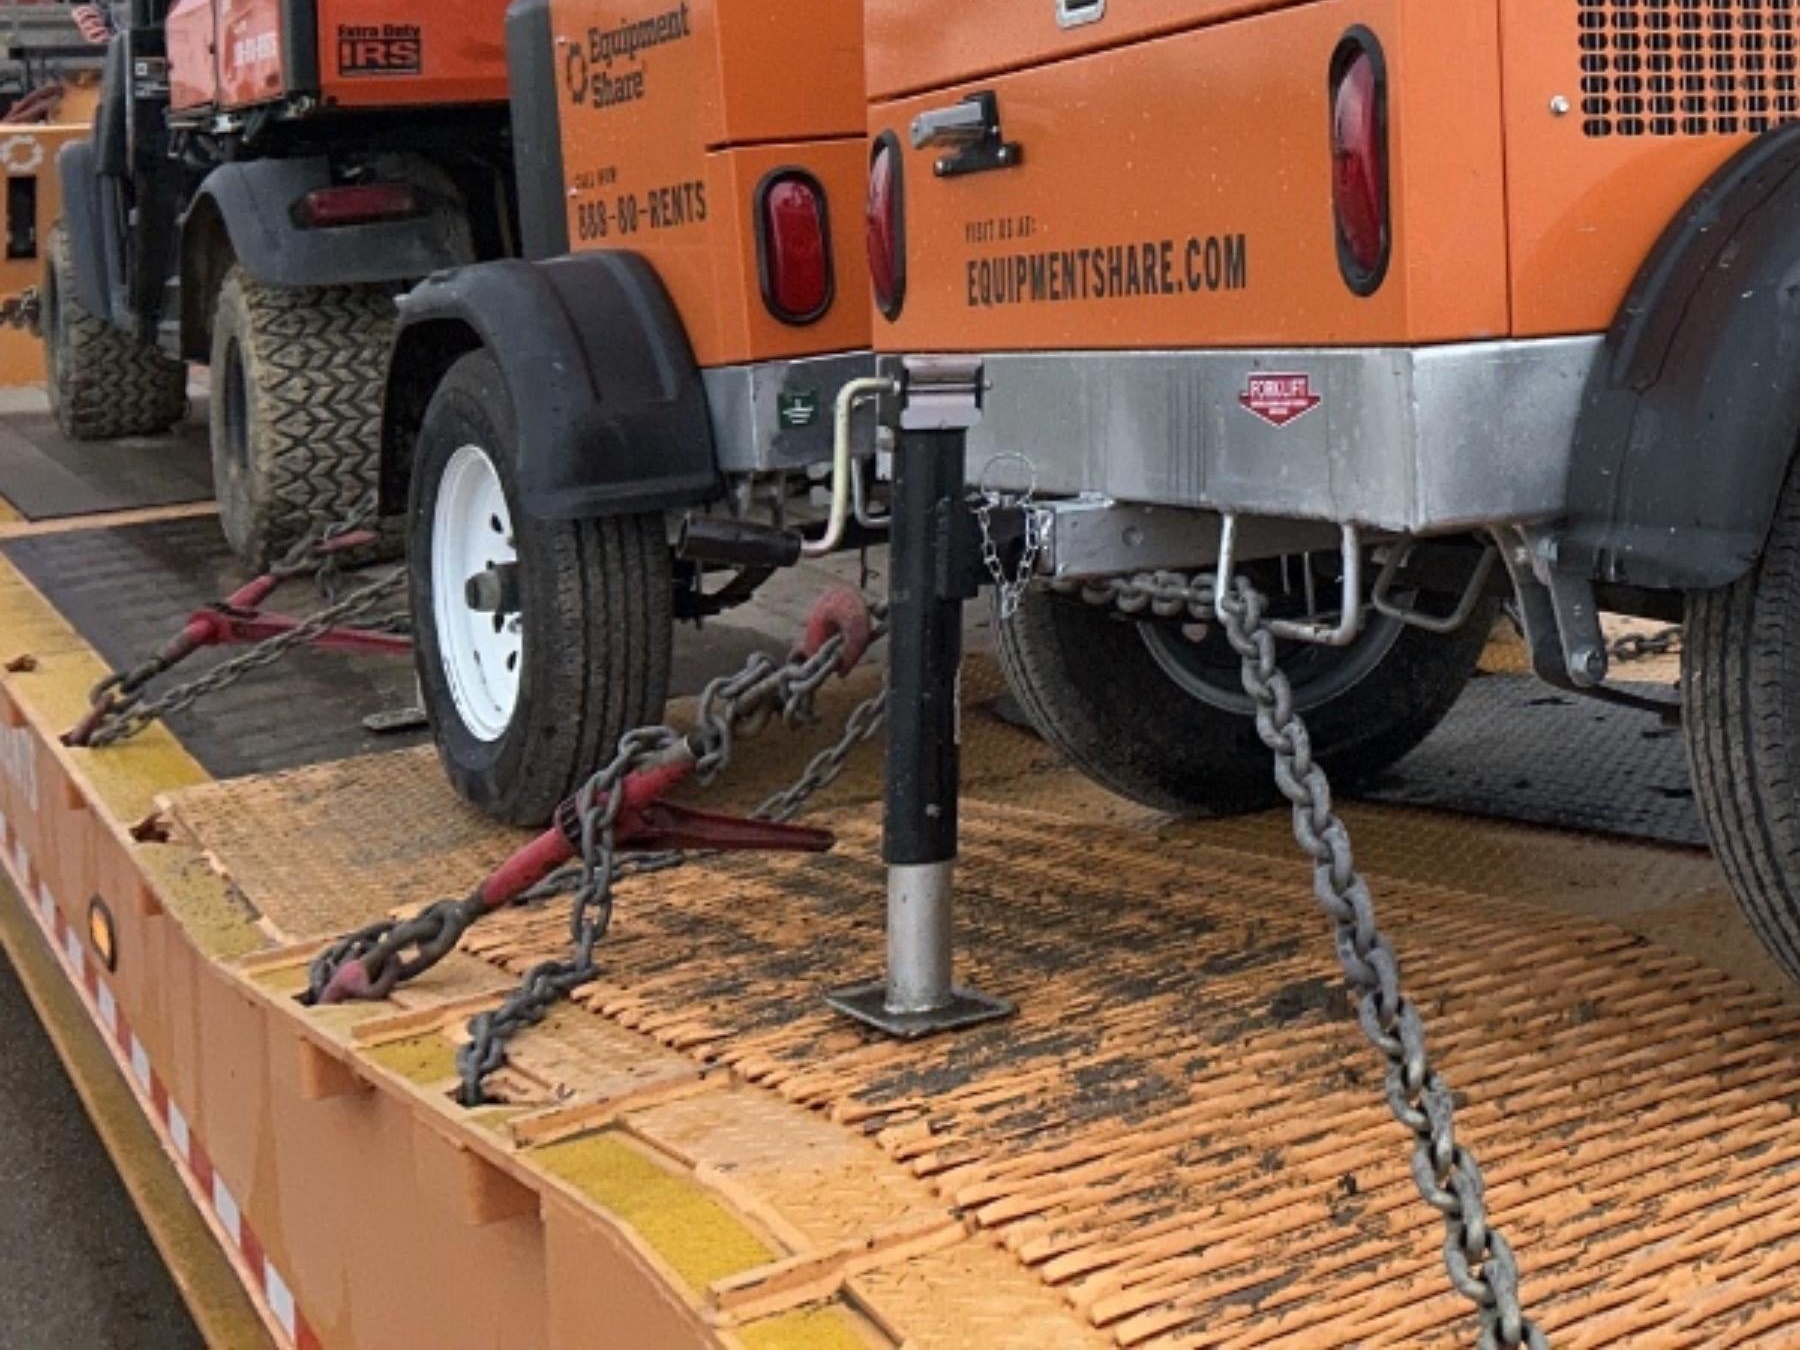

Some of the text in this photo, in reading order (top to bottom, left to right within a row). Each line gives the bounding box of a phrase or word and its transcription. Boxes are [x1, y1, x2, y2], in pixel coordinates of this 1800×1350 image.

[338, 24, 378, 37] Extra
[588, 1, 690, 68] Equipment
[341, 41, 417, 66] IRS
[591, 71, 643, 109] Share
[965, 219, 994, 242] VISIT
[967, 233, 1247, 308] EQUIPMENTSHARE.COM
